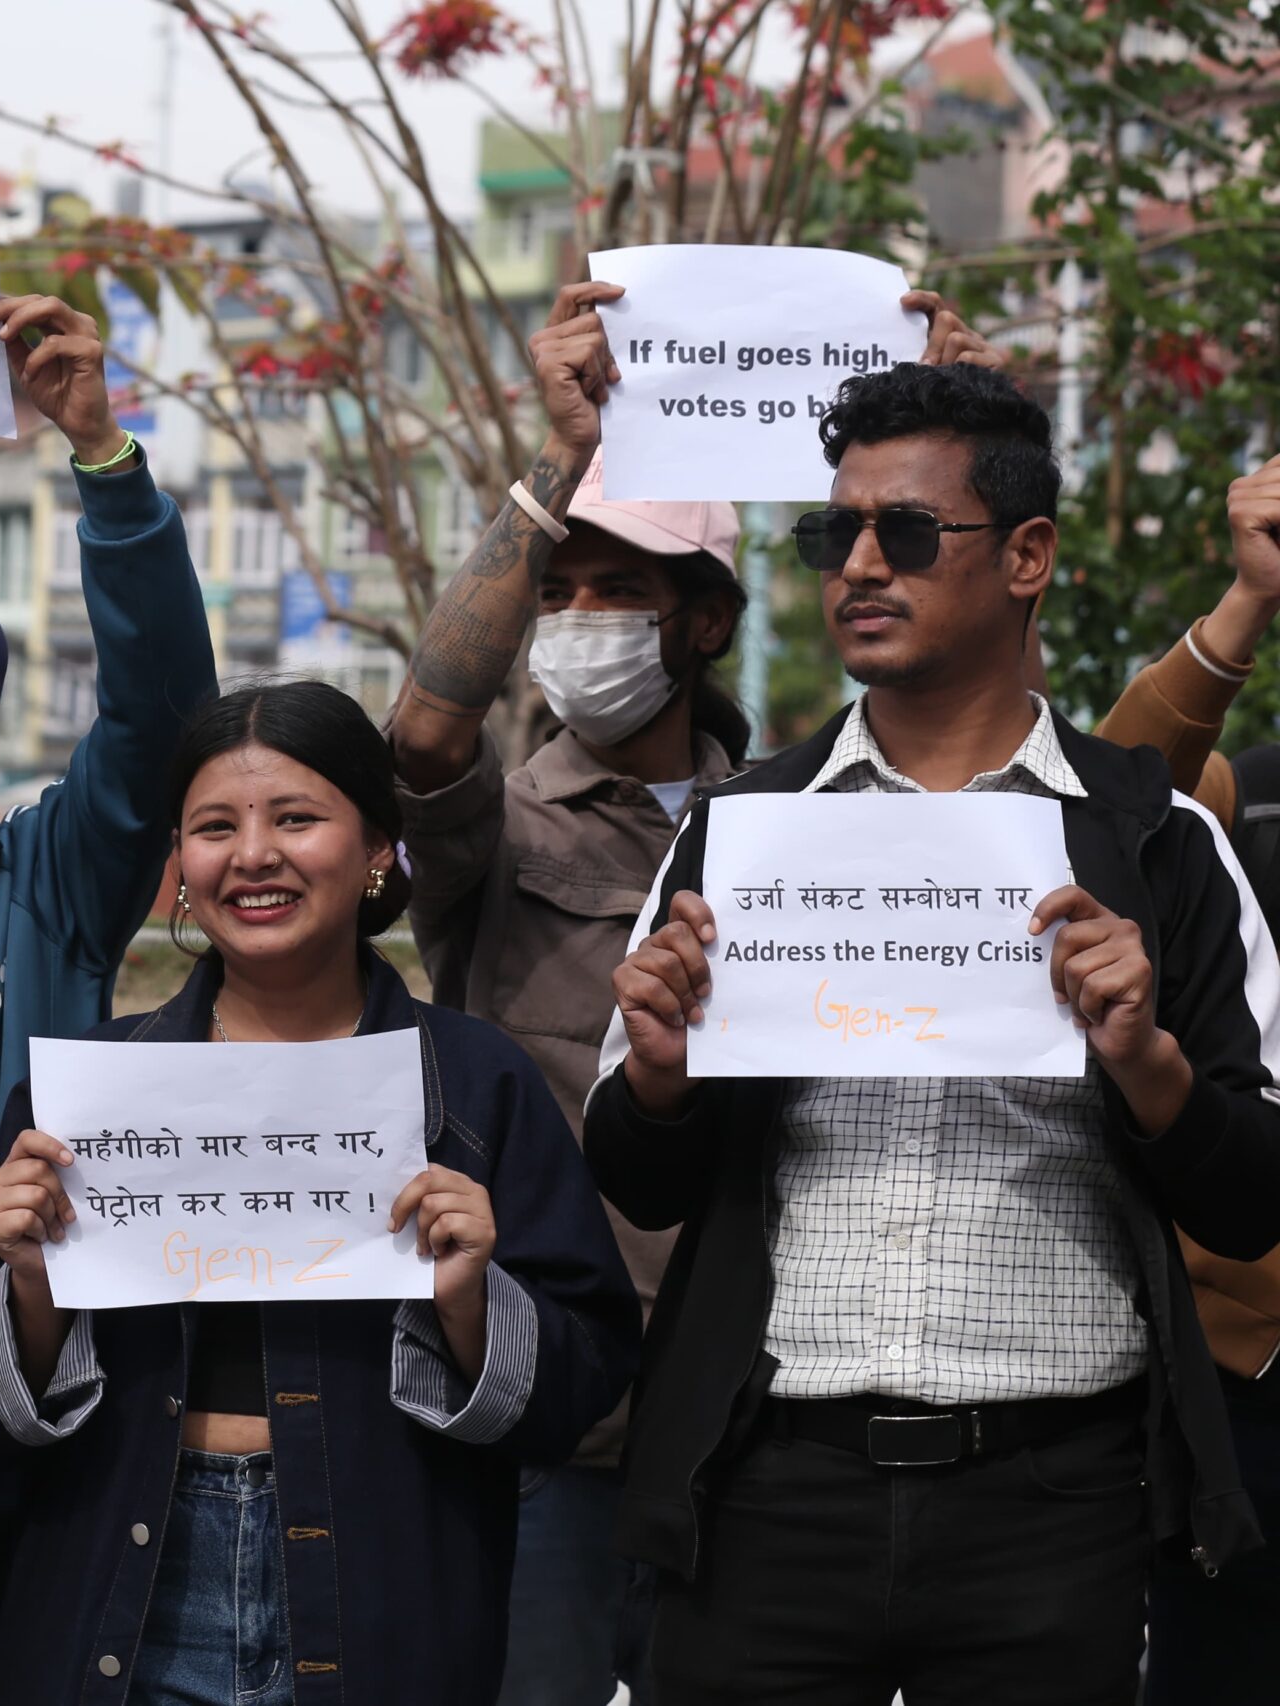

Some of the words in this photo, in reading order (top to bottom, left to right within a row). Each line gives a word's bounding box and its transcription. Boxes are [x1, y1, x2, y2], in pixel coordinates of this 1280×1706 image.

[629, 338, 654, 364] If
[663, 339, 726, 365] fuel
[736, 346, 812, 372] goes
[658, 393, 747, 418] votes
[757, 399, 797, 425] go
[731, 878, 786, 911] उर्जा
[796, 881, 867, 911] संकट
[877, 877, 983, 911] सम्बोधन
[723, 939, 826, 962] Address
[832, 939, 876, 962] the
[883, 940, 970, 967] Energy
[977, 939, 1044, 963] Crisis
[68, 1127, 184, 1162] महँगीको
[195, 1135, 249, 1158] मार
[260, 1133, 321, 1157] बन्द
[333, 1130, 384, 1159] गर,
[84, 1185, 165, 1228] पेट्रोल
[176, 1192, 227, 1217] कर
[239, 1191, 296, 1215] कम
[307, 1190, 351, 1214] गर
[368, 1192, 375, 1213] !
[162, 1230, 351, 1299] Gen-Z
